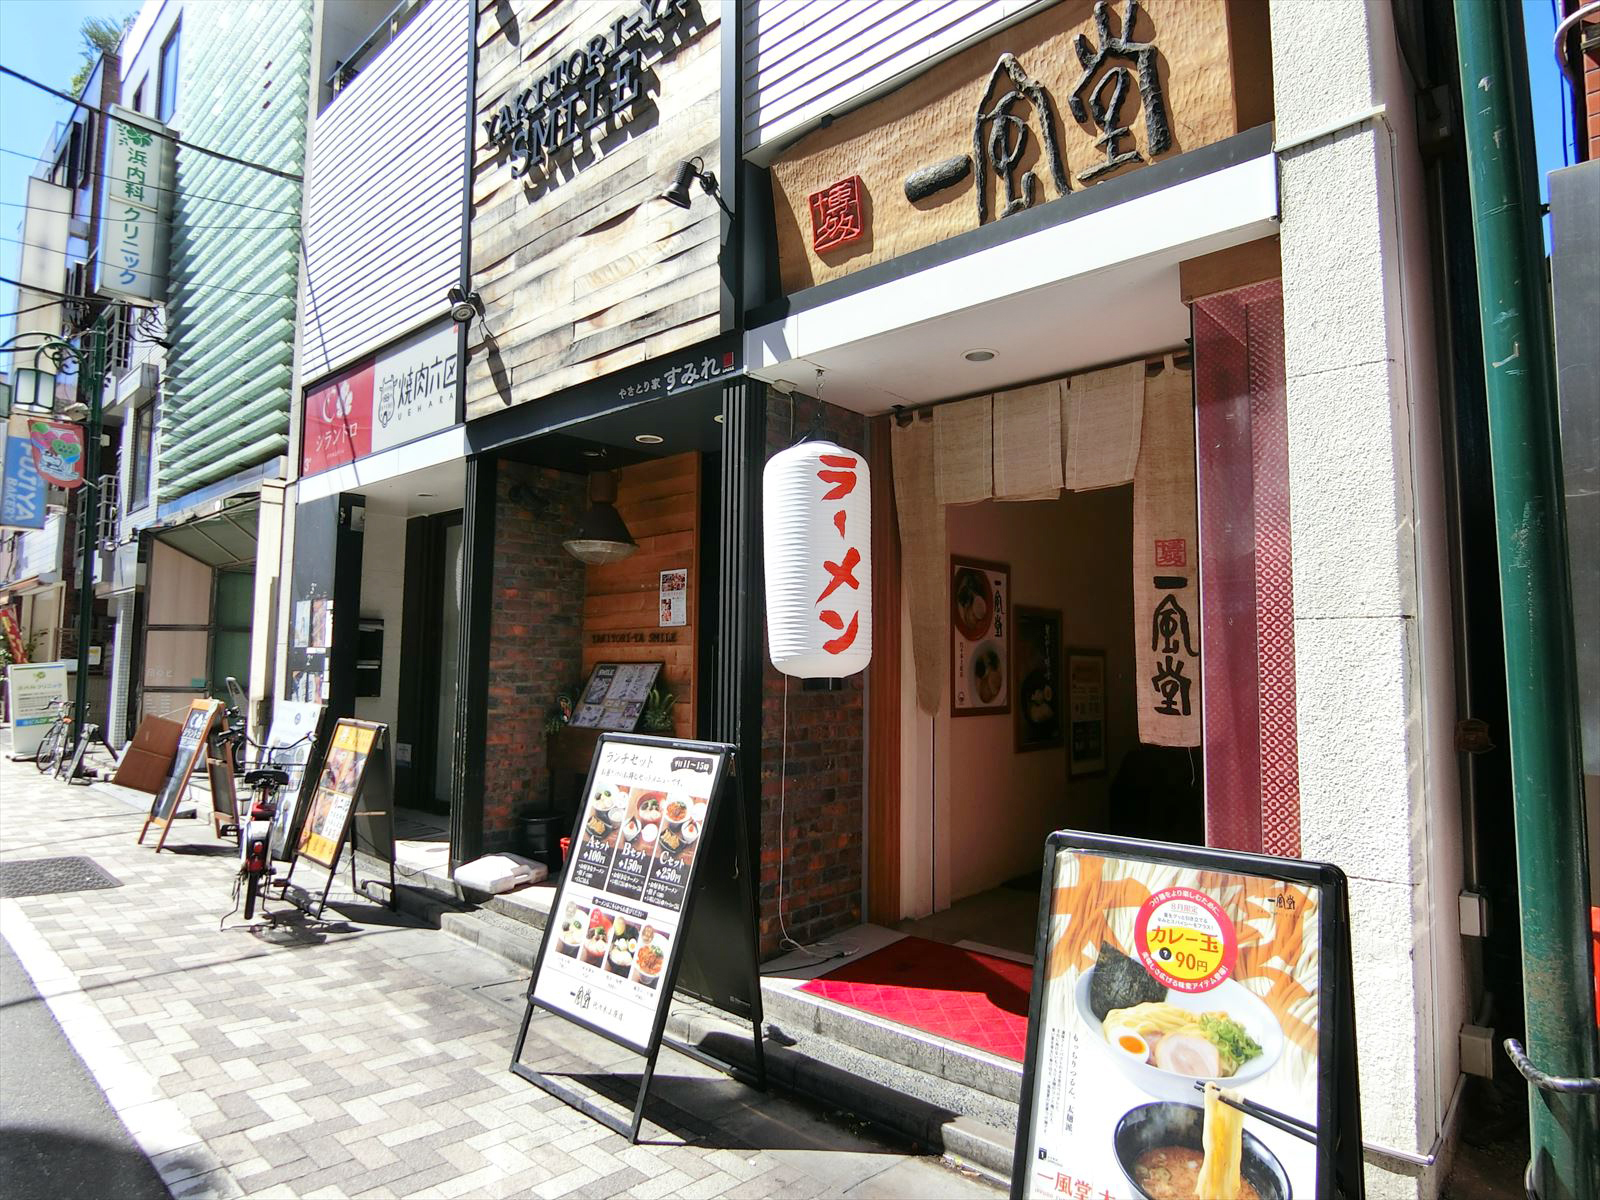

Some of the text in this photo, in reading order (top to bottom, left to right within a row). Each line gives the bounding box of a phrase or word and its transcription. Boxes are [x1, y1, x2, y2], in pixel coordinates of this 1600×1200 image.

[512, 50, 643, 180] SMILE
[904, 0, 1173, 226] 一風堂
[119, 147, 147, 285] 浜内科クリニック
[397, 353, 457, 409] 焼肉六区
[664, 356, 721, 390] すみれ
[398, 392, 454, 421] UEHARA
[315, 422, 358, 453] シラントロ
[815, 454, 861, 655] ラーメン
[1150, 575, 1200, 716] 一風堂
[606, 751, 654, 768] ランチセット
[587, 835, 610, 851] Aセット
[622, 842, 646, 860] Bセット
[660, 850, 685, 869] Cセット
[1267, 893, 1296, 910] 一風堂
[1150, 926, 1219, 953] カレー玉
[1175, 952, 1208, 973] 90円
[1037, 1171, 1092, 1200] 一風堂
